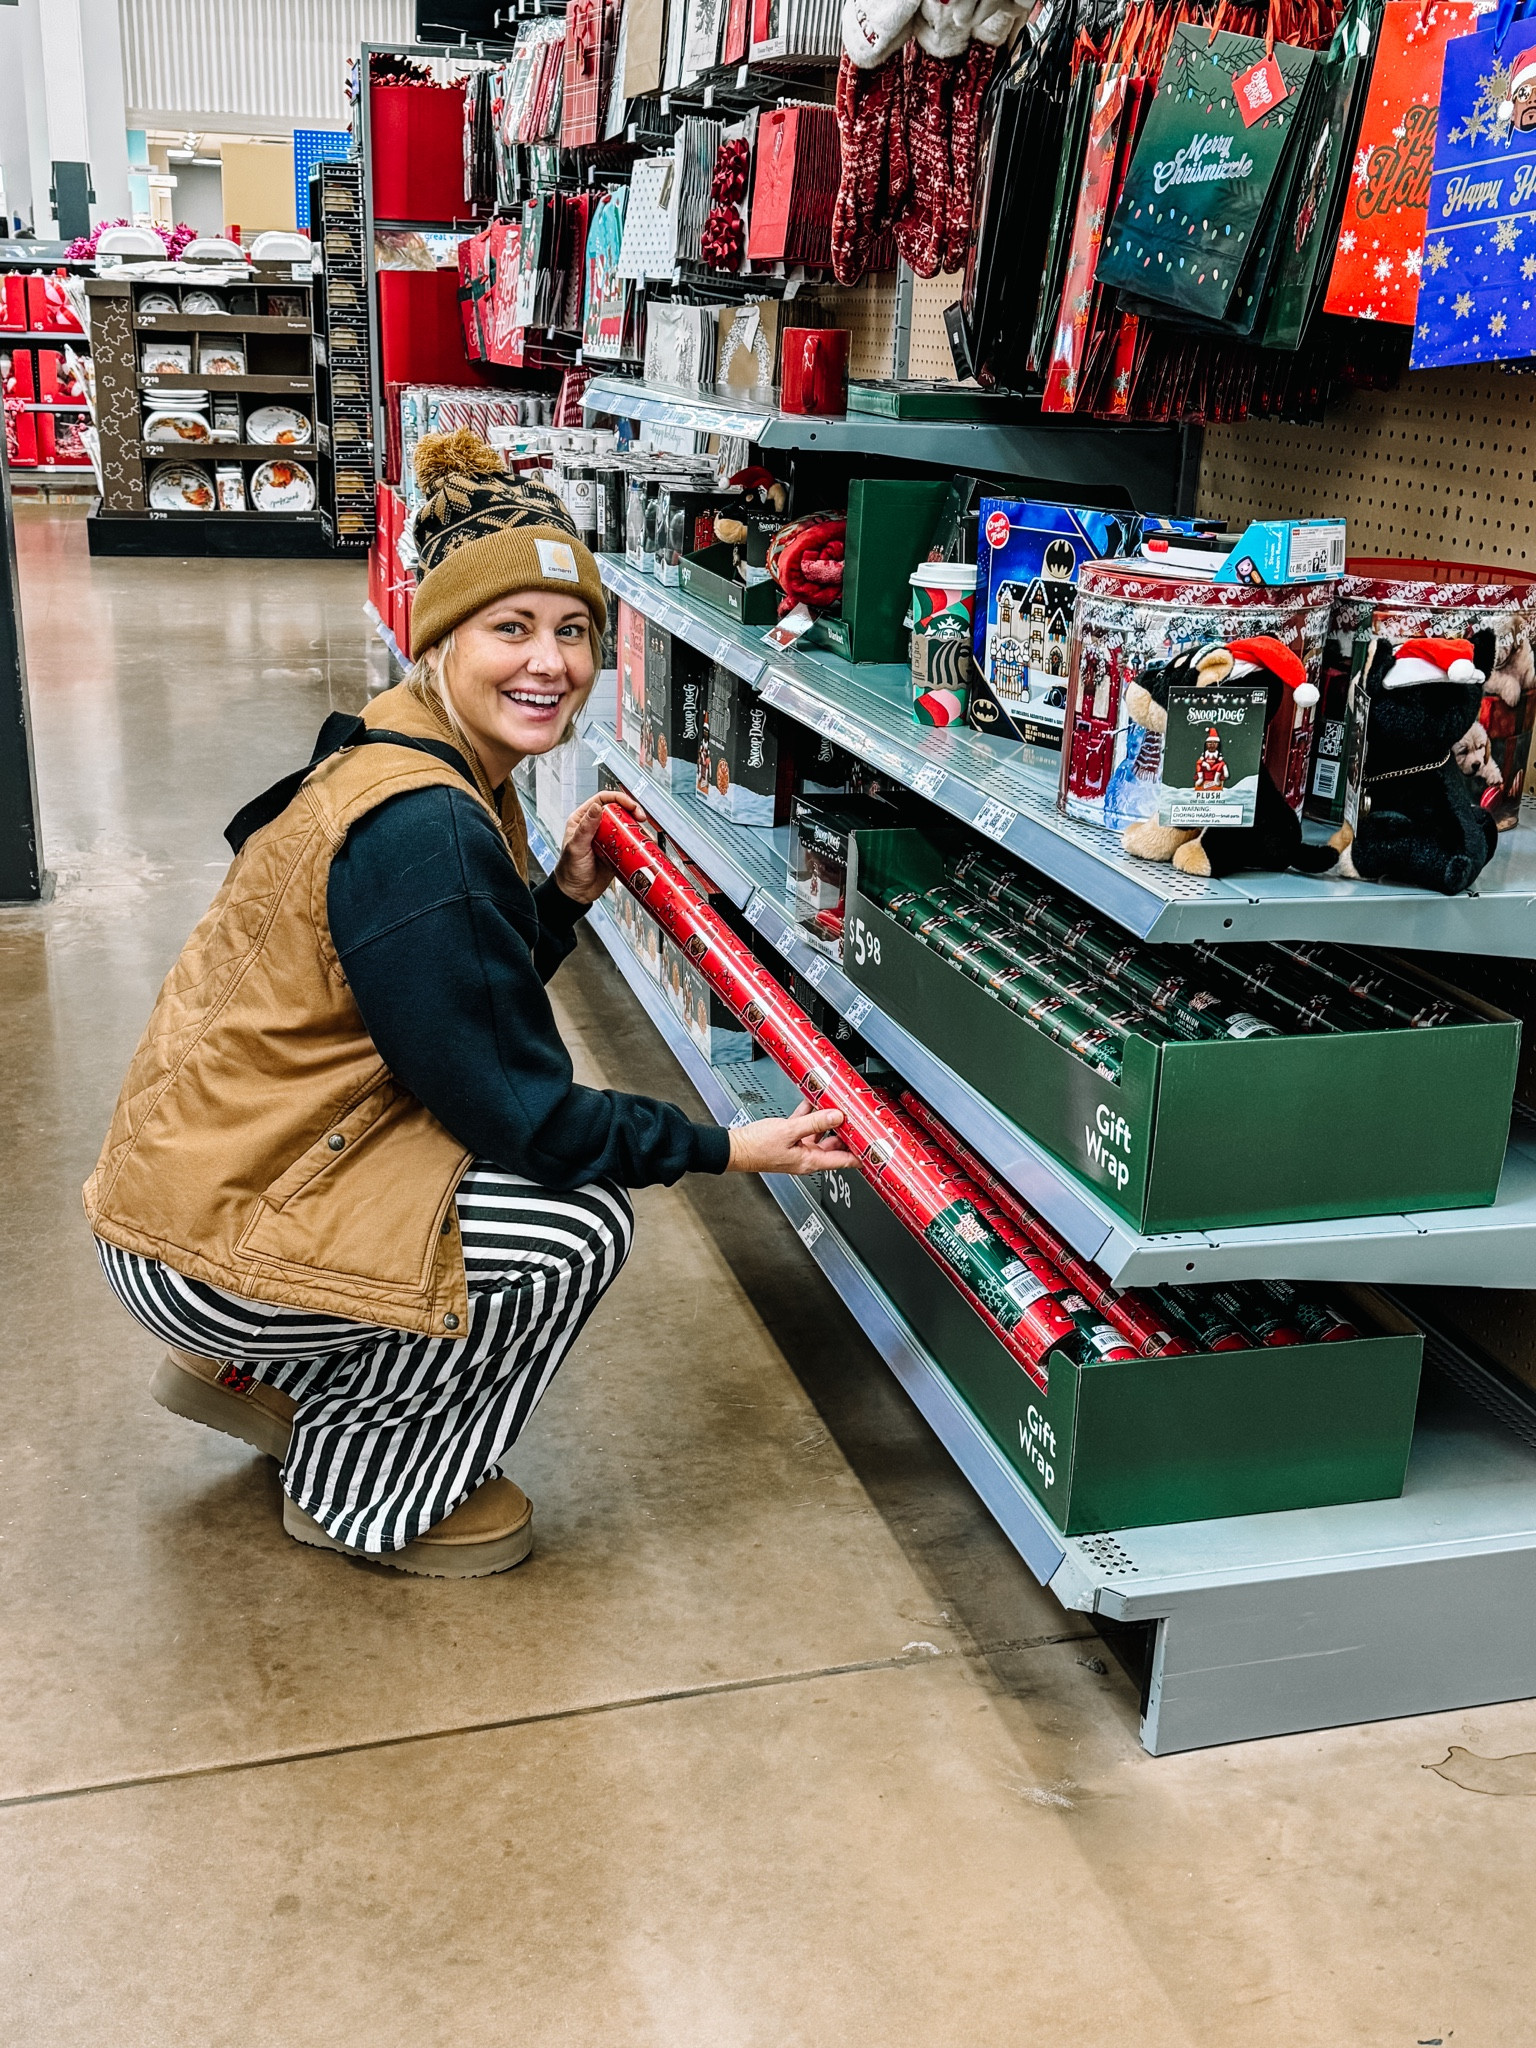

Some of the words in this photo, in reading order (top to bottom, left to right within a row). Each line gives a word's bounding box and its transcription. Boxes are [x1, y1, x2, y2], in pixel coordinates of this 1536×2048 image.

[1175, 133, 1234, 163] Merry
[1153, 153, 1253, 194] Chrismizzle
[1442, 174, 1504, 217] Happy
[682, 683, 698, 711] DOGG
[682, 711, 699, 740] SNOOP
[748, 708, 766, 738] DOGG
[1187, 707, 1217, 723] SNOOP
[1218, 707, 1245, 724] DOGG
[747, 738, 765, 769] SNOOP
[1196, 792, 1221, 800] PLUSH
[1096, 1104, 1132, 1154] Gift
[1085, 1125, 1130, 1191] Wrap
[940, 1227, 969, 1262] PREMIUM
[1027, 1404, 1057, 1458] Gift
[1018, 1418, 1055, 1489] Wrap
